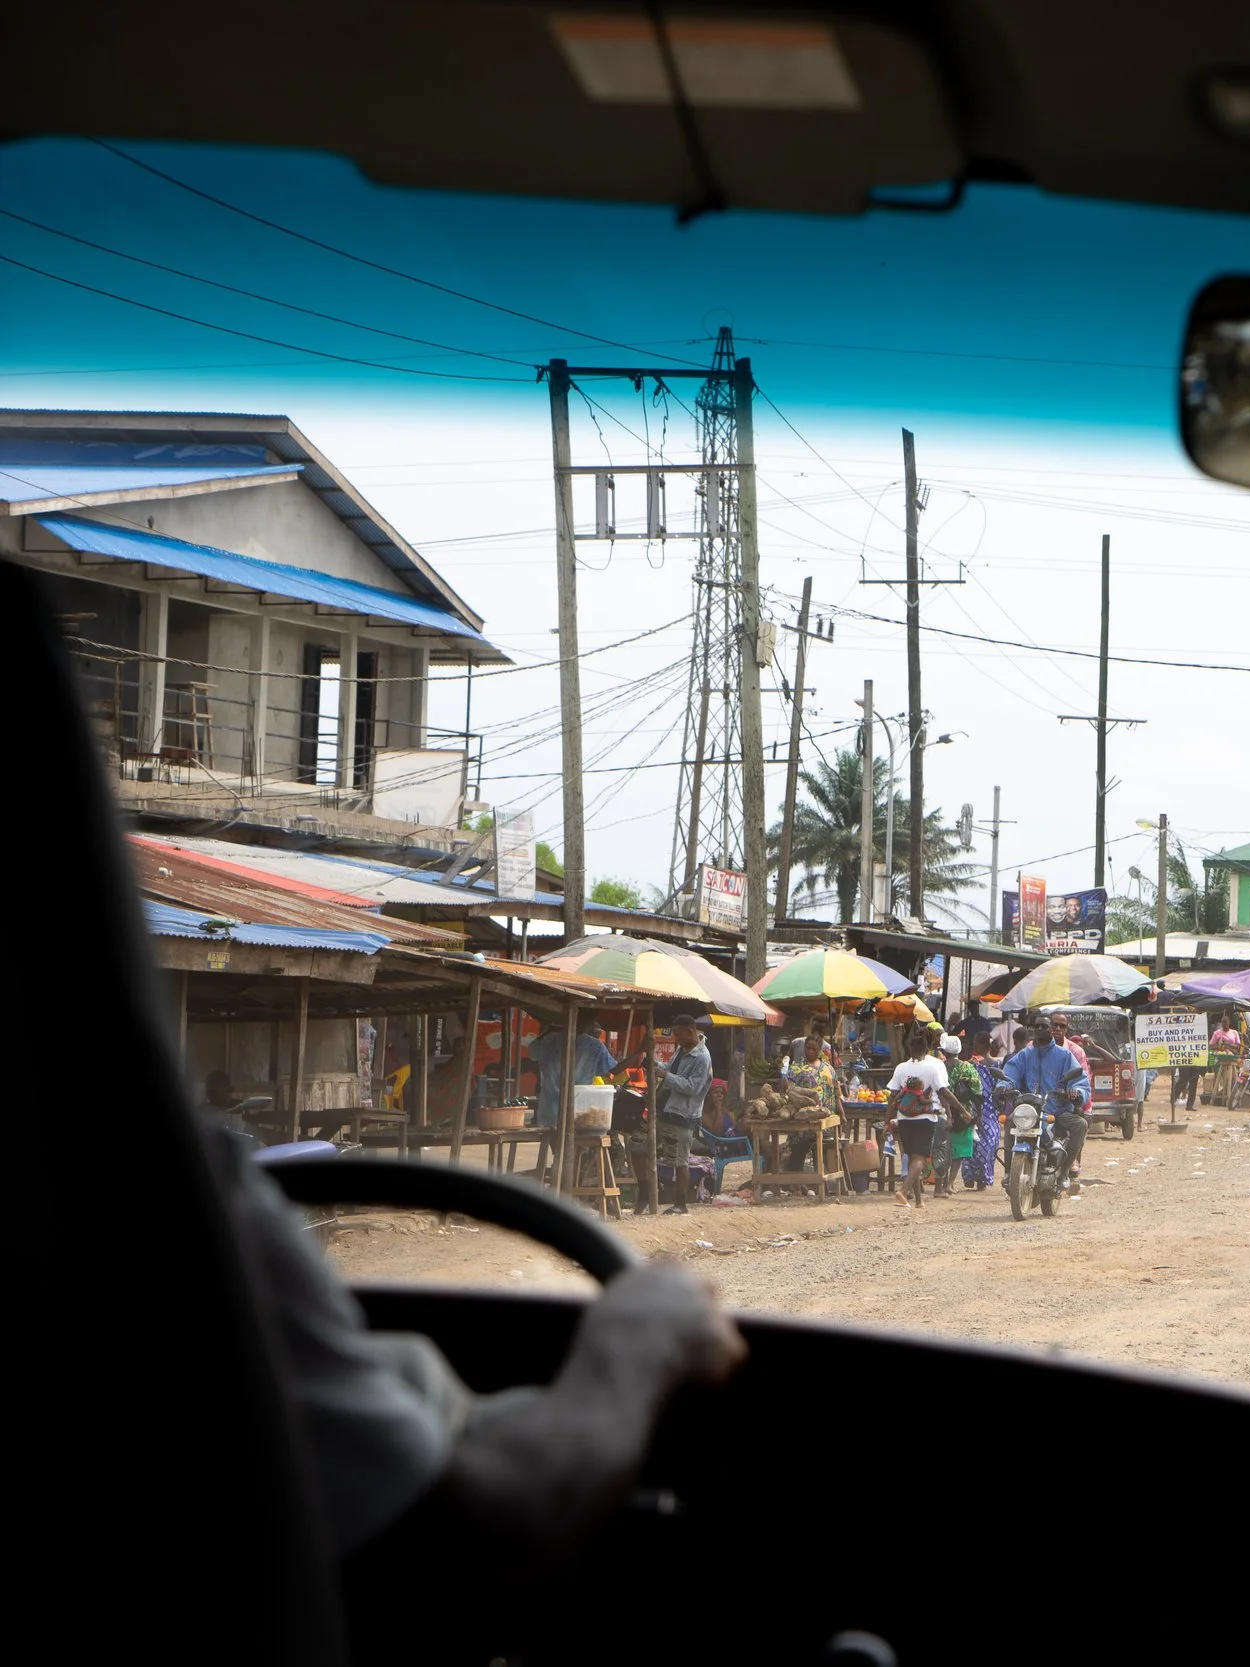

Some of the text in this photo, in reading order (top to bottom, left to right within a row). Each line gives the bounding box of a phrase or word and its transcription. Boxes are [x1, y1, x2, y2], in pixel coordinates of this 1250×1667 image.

[705, 870, 744, 894] SATCON
[1147, 1015, 1196, 1025] SATCON
[1148, 1029, 1163, 1037] BUY
[1168, 1044, 1187, 1052] BUY
[1168, 1051, 1200, 1059] TOKEN
[1169, 1058, 1194, 1066] HERE
